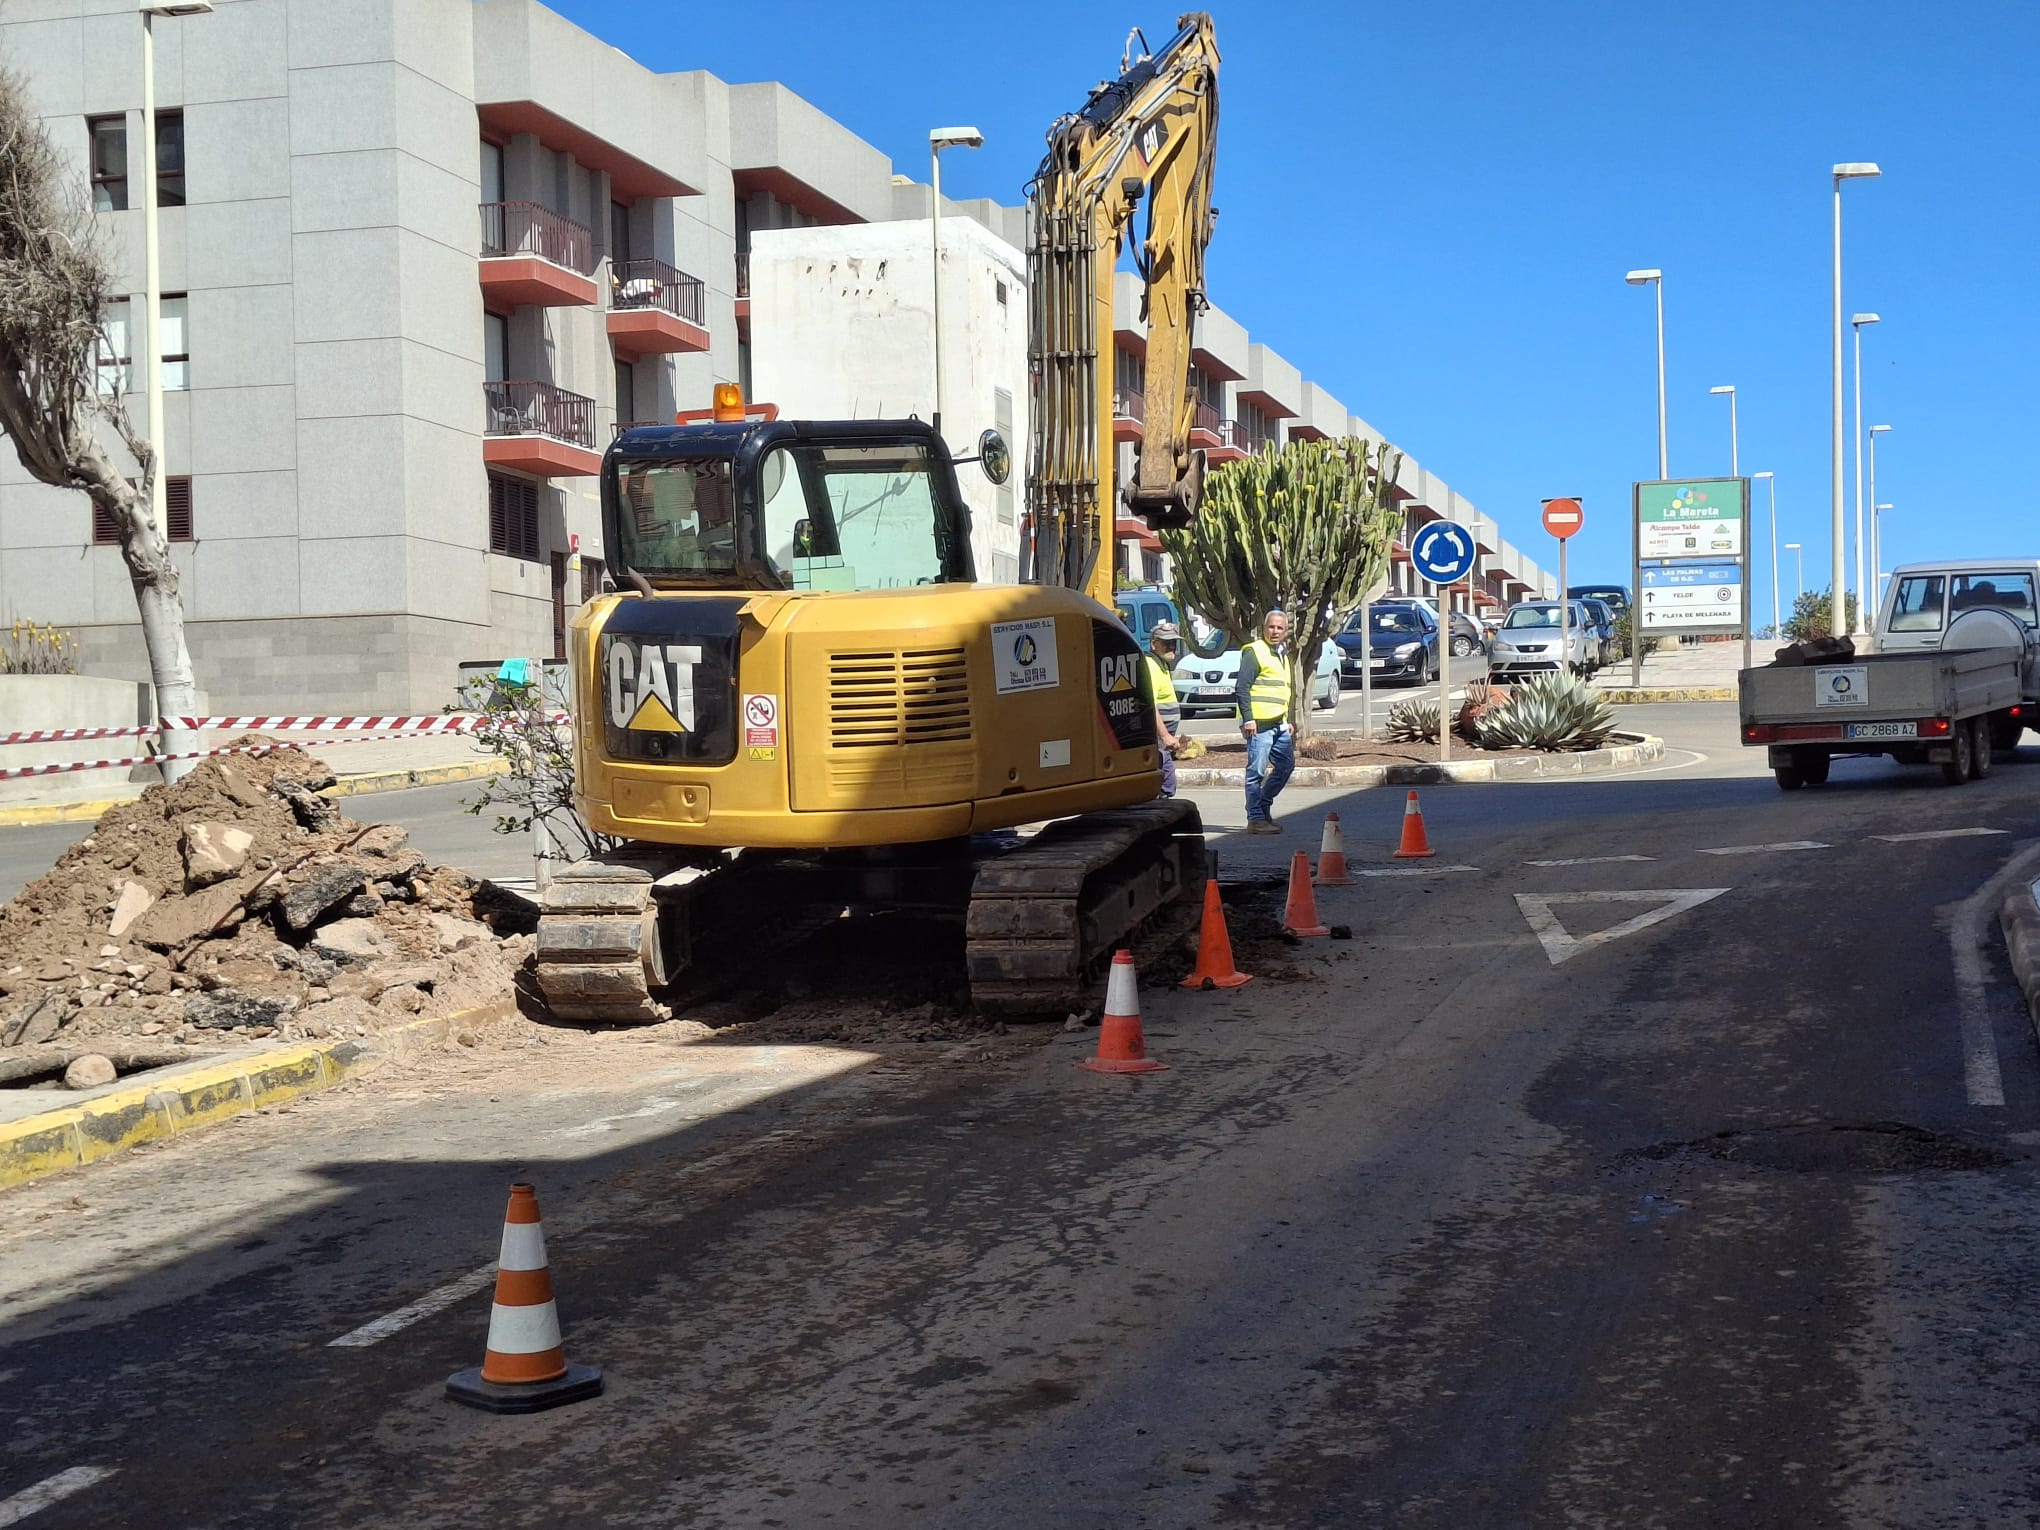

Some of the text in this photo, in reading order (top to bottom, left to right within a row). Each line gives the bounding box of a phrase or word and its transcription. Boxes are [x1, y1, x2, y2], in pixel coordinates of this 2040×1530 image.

[1143, 123, 1159, 163] CAT
[609, 641, 702, 733] CAT
[1101, 653, 1139, 693] CAT
[1855, 724, 1915, 736] GC 2868 AZ
